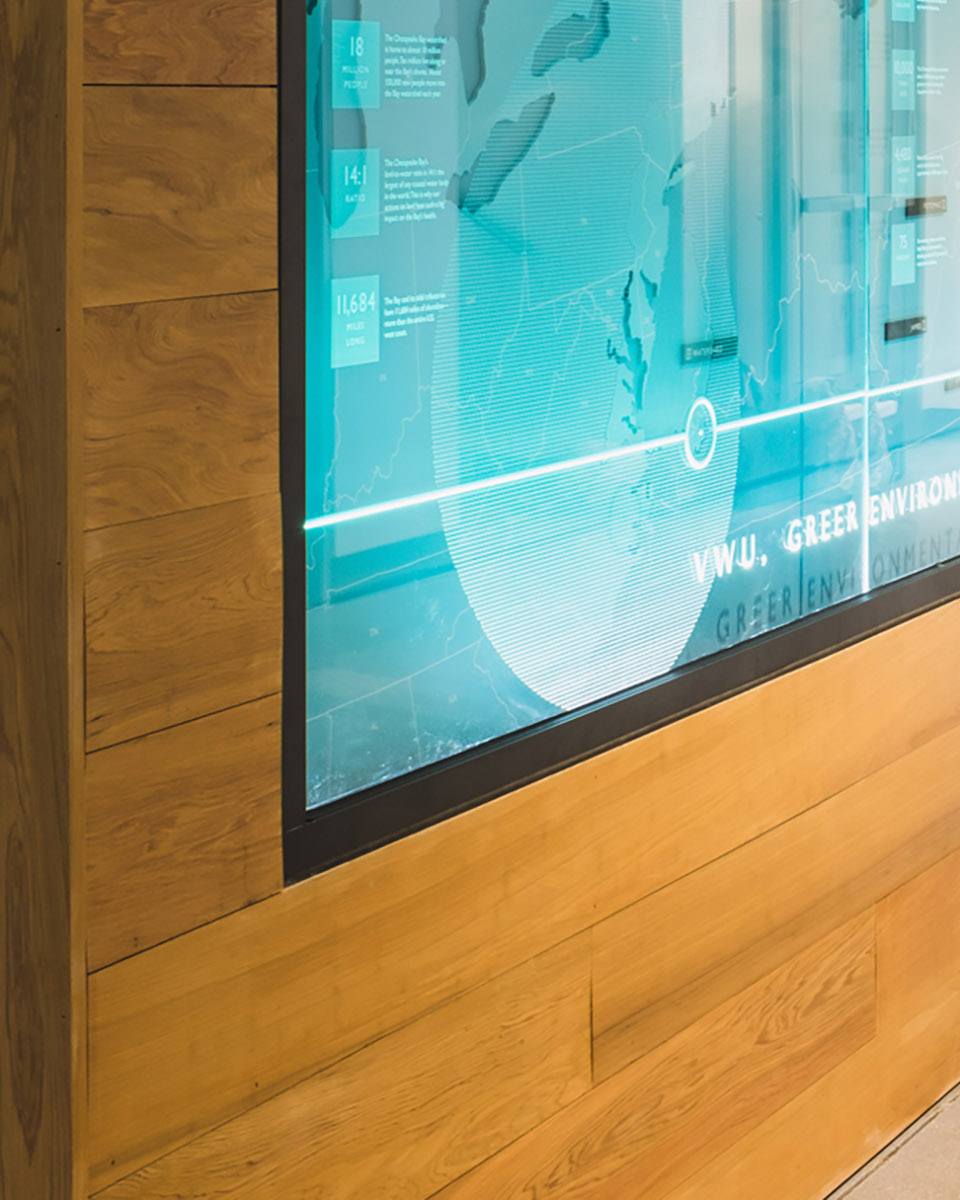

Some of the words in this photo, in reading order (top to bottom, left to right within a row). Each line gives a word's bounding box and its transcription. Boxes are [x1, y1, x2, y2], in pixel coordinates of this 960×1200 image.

[350, 36, 365, 56] 18
[341, 64, 370, 74] MILLION
[344, 165, 367, 186] 14:1
[337, 291, 376, 317] 11,684
[692, 533, 768, 583] VWU,
[785, 500, 859, 553] GREER
